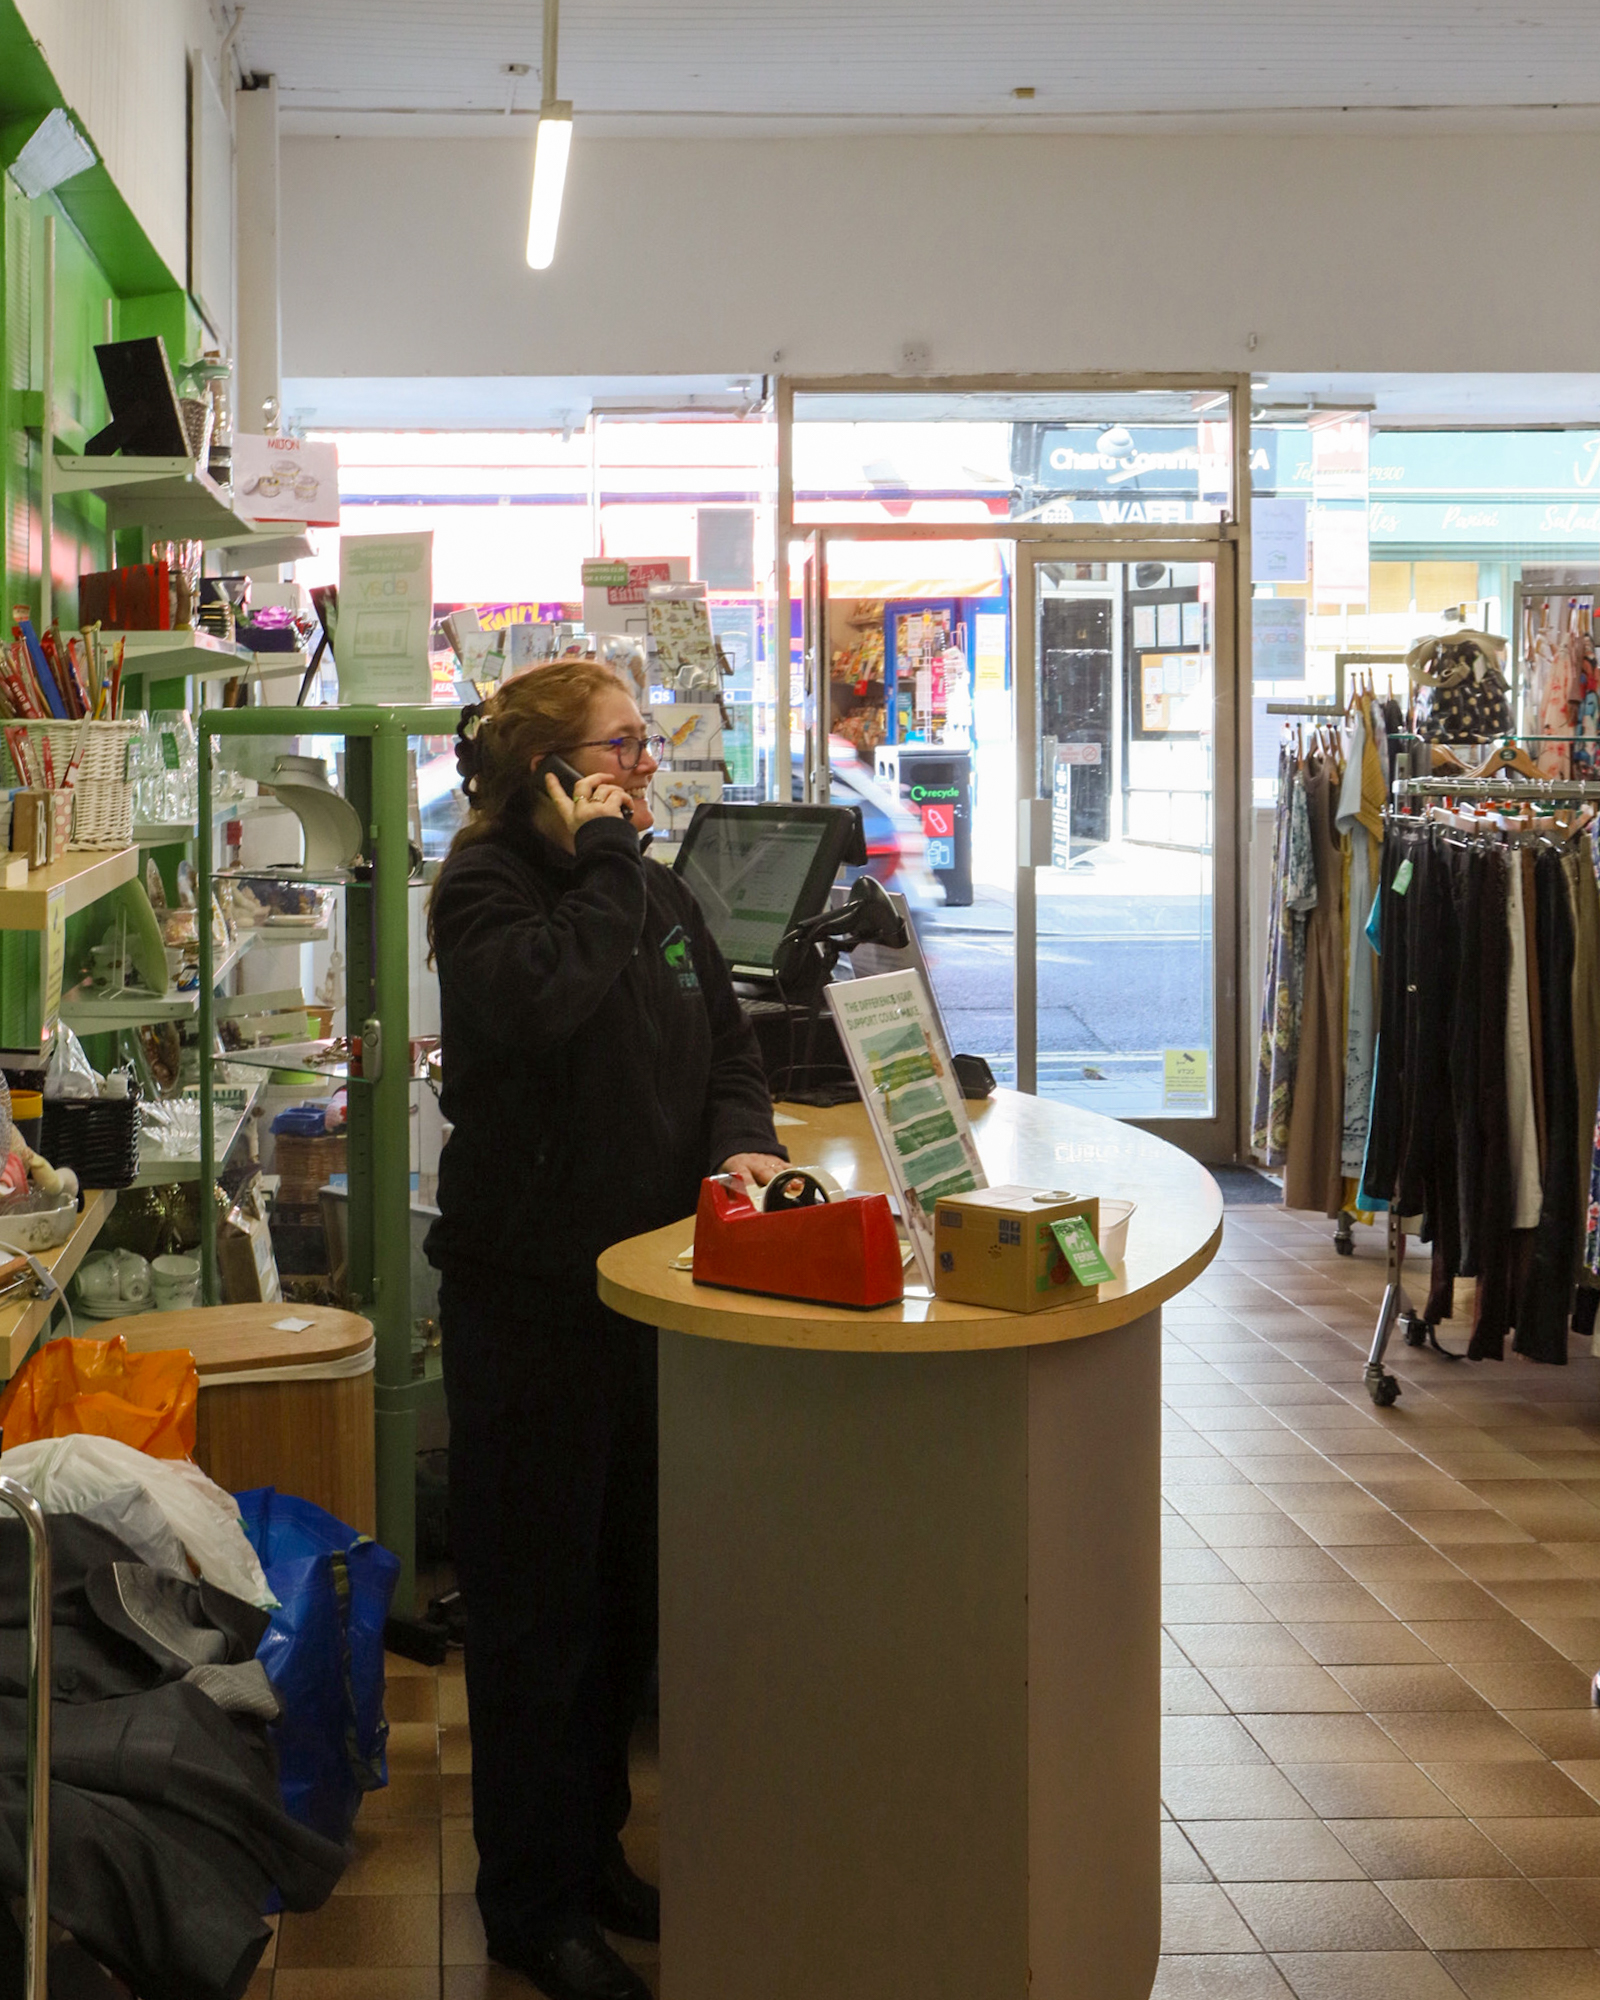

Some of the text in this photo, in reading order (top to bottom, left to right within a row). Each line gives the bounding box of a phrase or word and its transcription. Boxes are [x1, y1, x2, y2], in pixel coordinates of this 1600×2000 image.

[267, 438, 300, 451] MILTON
[1441, 505, 1500, 531] Panini
[479, 602, 542, 632] Twirl
[927, 786, 960, 799] recycle
[844, 990, 914, 1013] THE DIFFERENCE YOUR
[846, 1014, 878, 1031] SUPPORT
[878, 1010, 900, 1023] COULD
